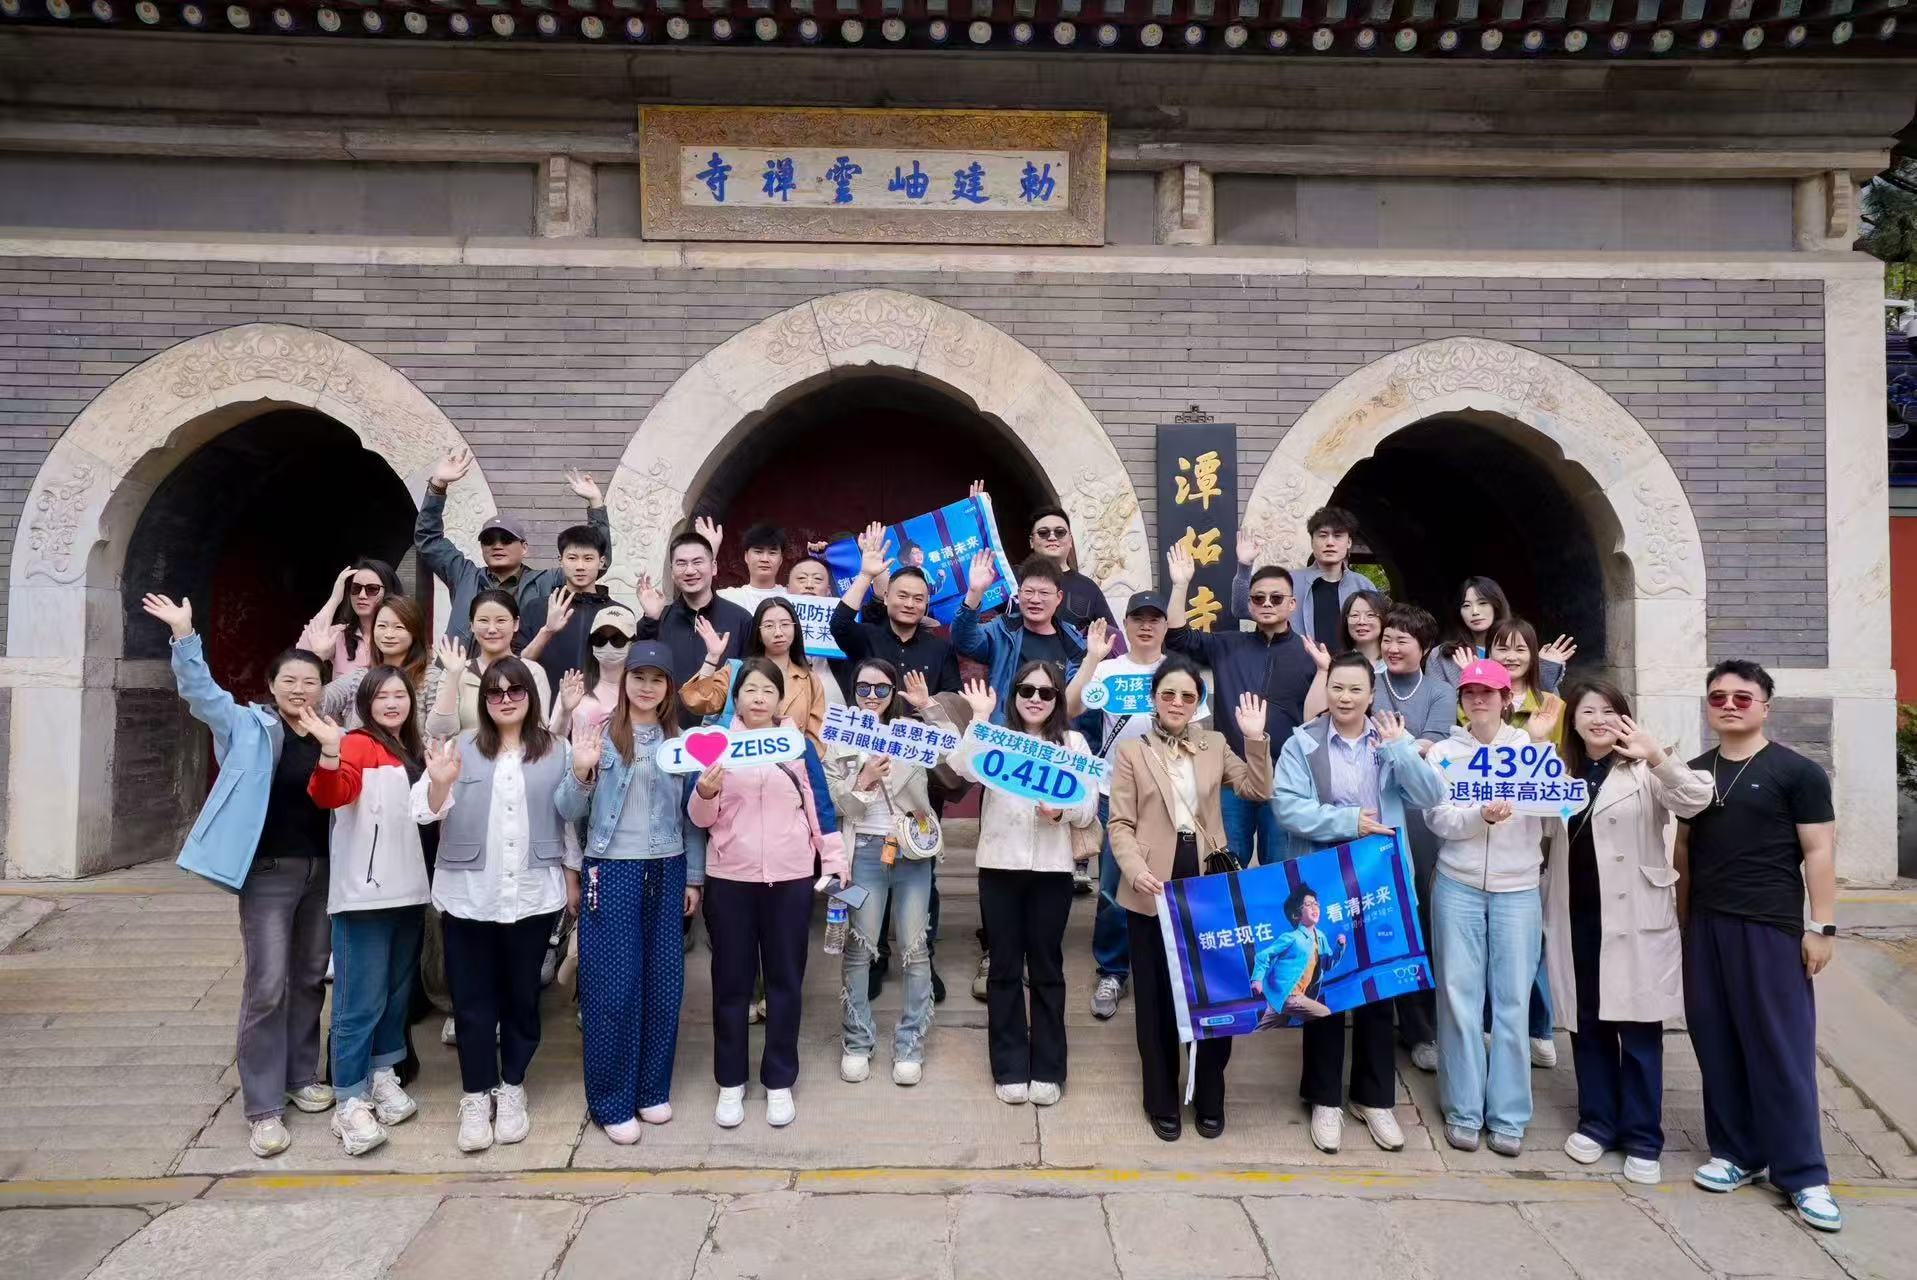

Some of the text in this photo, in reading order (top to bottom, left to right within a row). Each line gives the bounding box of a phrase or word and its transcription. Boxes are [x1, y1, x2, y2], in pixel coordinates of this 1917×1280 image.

[928, 535, 980, 564] 看清未来
[673, 747, 682, 764] I
[730, 737, 790, 758] ZEISS
[822, 725, 936, 765] 蔡司眼健康沙龙
[972, 722, 1104, 777] 等效球镜度少增长
[1467, 745, 1562, 778] 43%
[982, 749, 1078, 799] 0.41D
[1449, 781, 1585, 802] 退轴率高达近
[1326, 885, 1391, 924] 看清未来
[1198, 922, 1274, 950] 锁定现在
